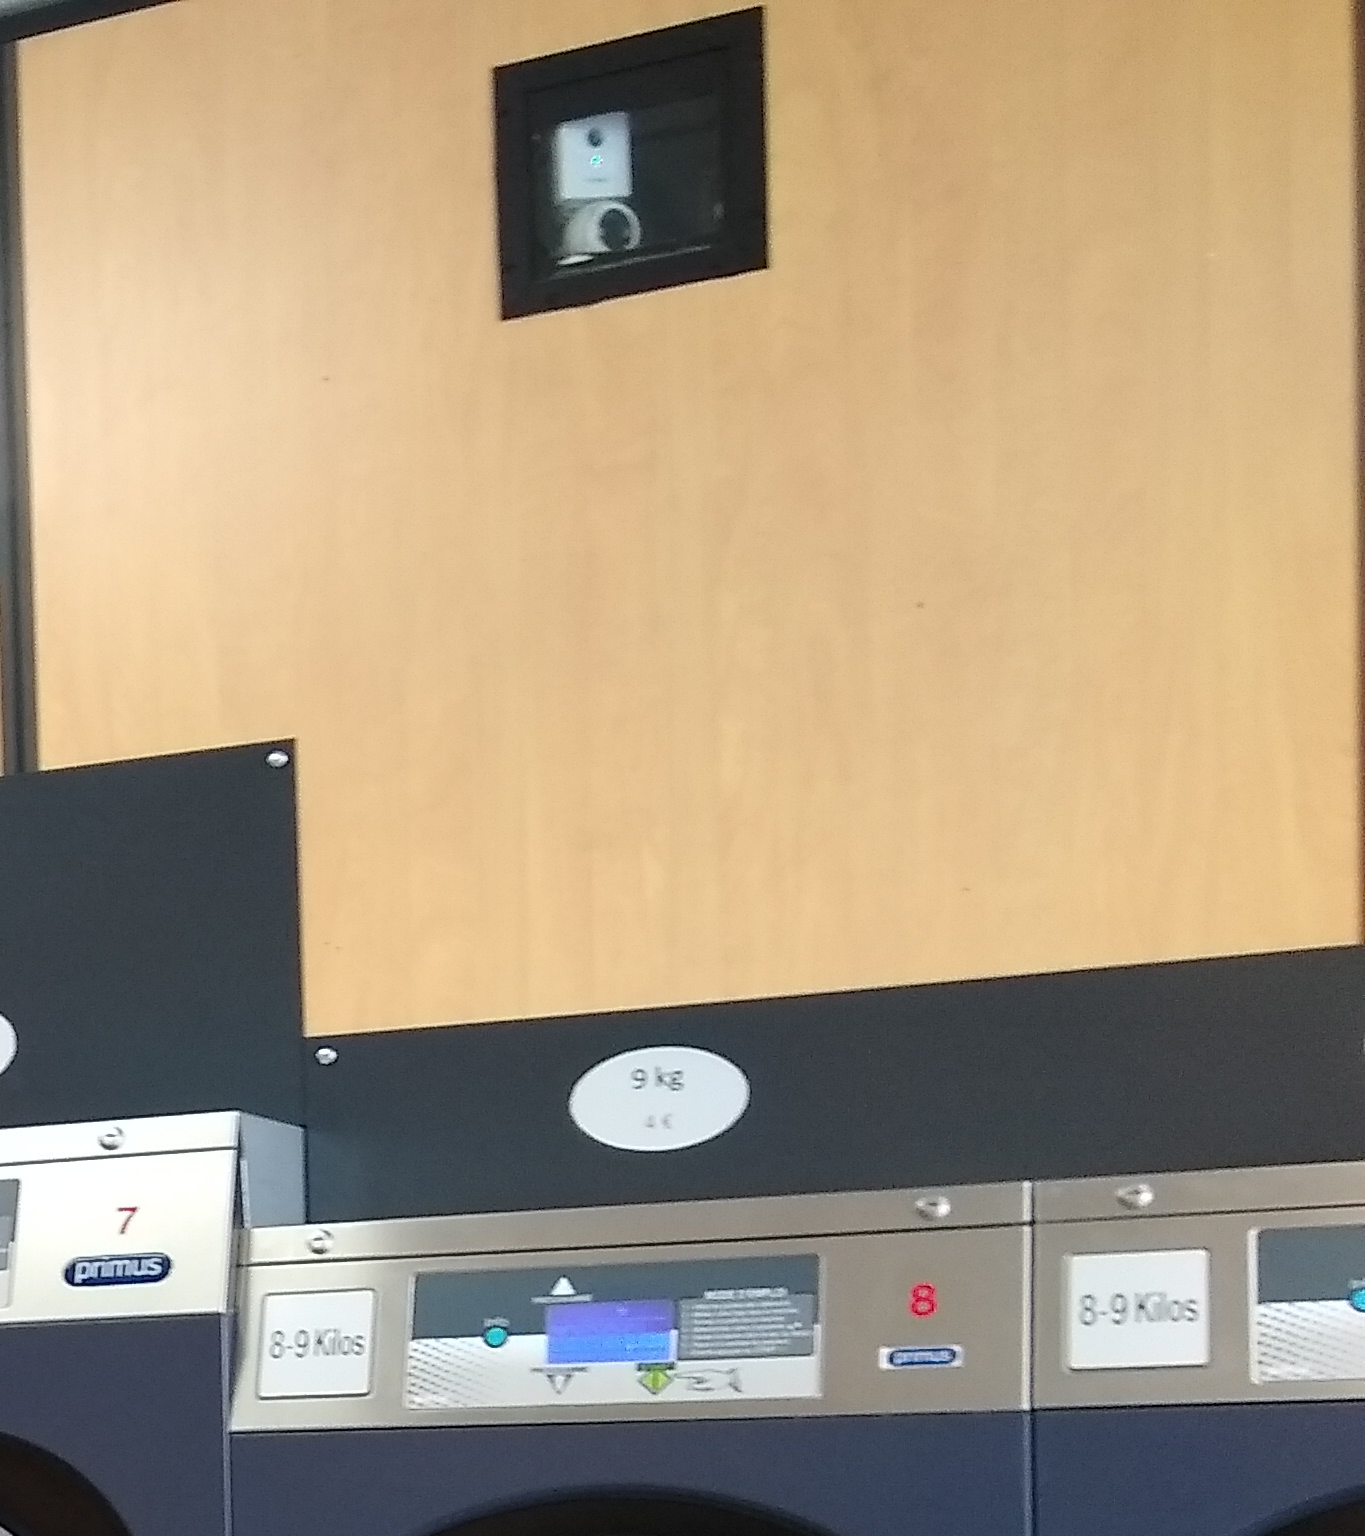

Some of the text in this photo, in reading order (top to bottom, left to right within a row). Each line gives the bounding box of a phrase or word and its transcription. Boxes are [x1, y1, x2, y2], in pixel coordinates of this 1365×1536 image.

[630, 1065, 685, 1092] 9 kg
[116, 1206, 139, 1235] 7
[73, 1256, 163, 1284] primus
[909, 1282, 938, 1318] 8
[1077, 1291, 1200, 1327] 8-9 Kilos
[268, 1327, 366, 1361] 8-9 Kilos
